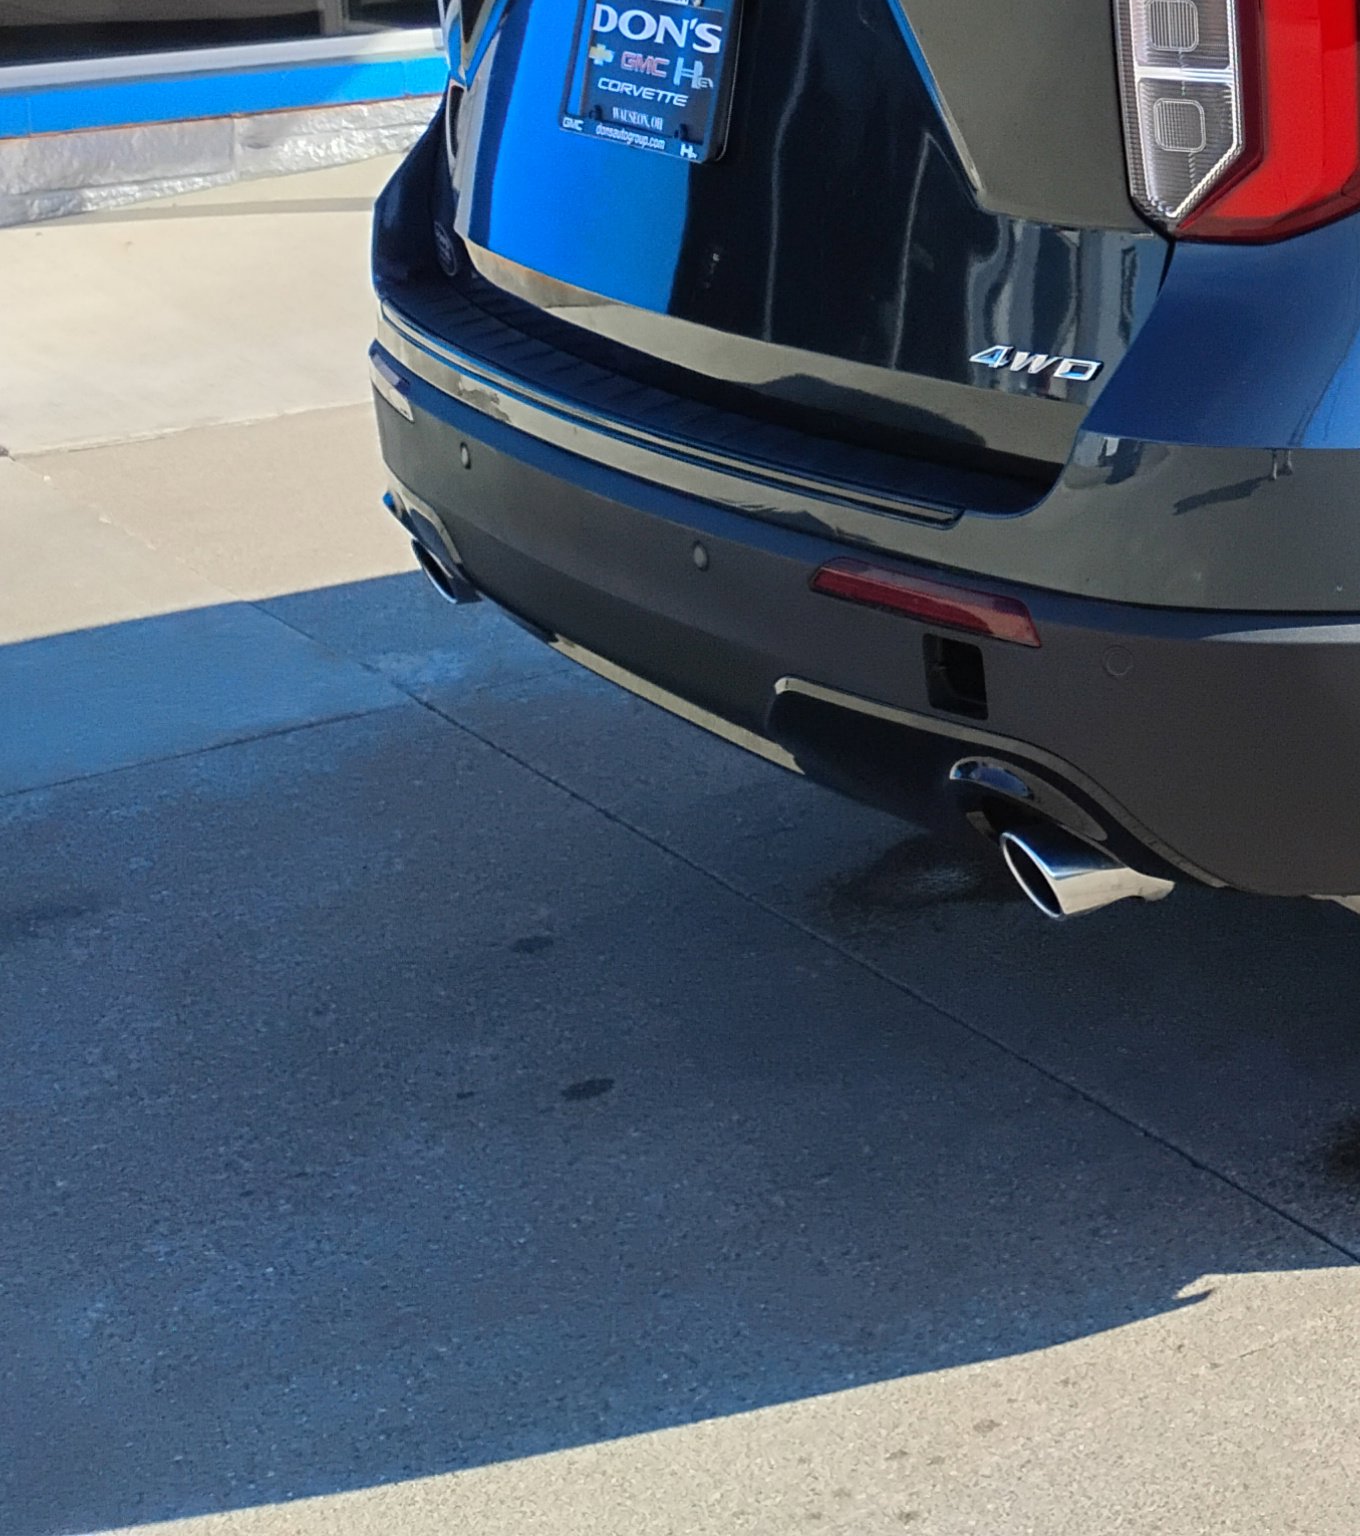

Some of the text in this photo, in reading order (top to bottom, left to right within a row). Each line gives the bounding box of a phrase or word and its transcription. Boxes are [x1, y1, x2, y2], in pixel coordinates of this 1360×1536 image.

[593, 3, 722, 53] DON'S
[620, 51, 670, 78] GMC
[598, 77, 689, 107] CORVETTE
[969, 345, 1101, 381] 4WD
